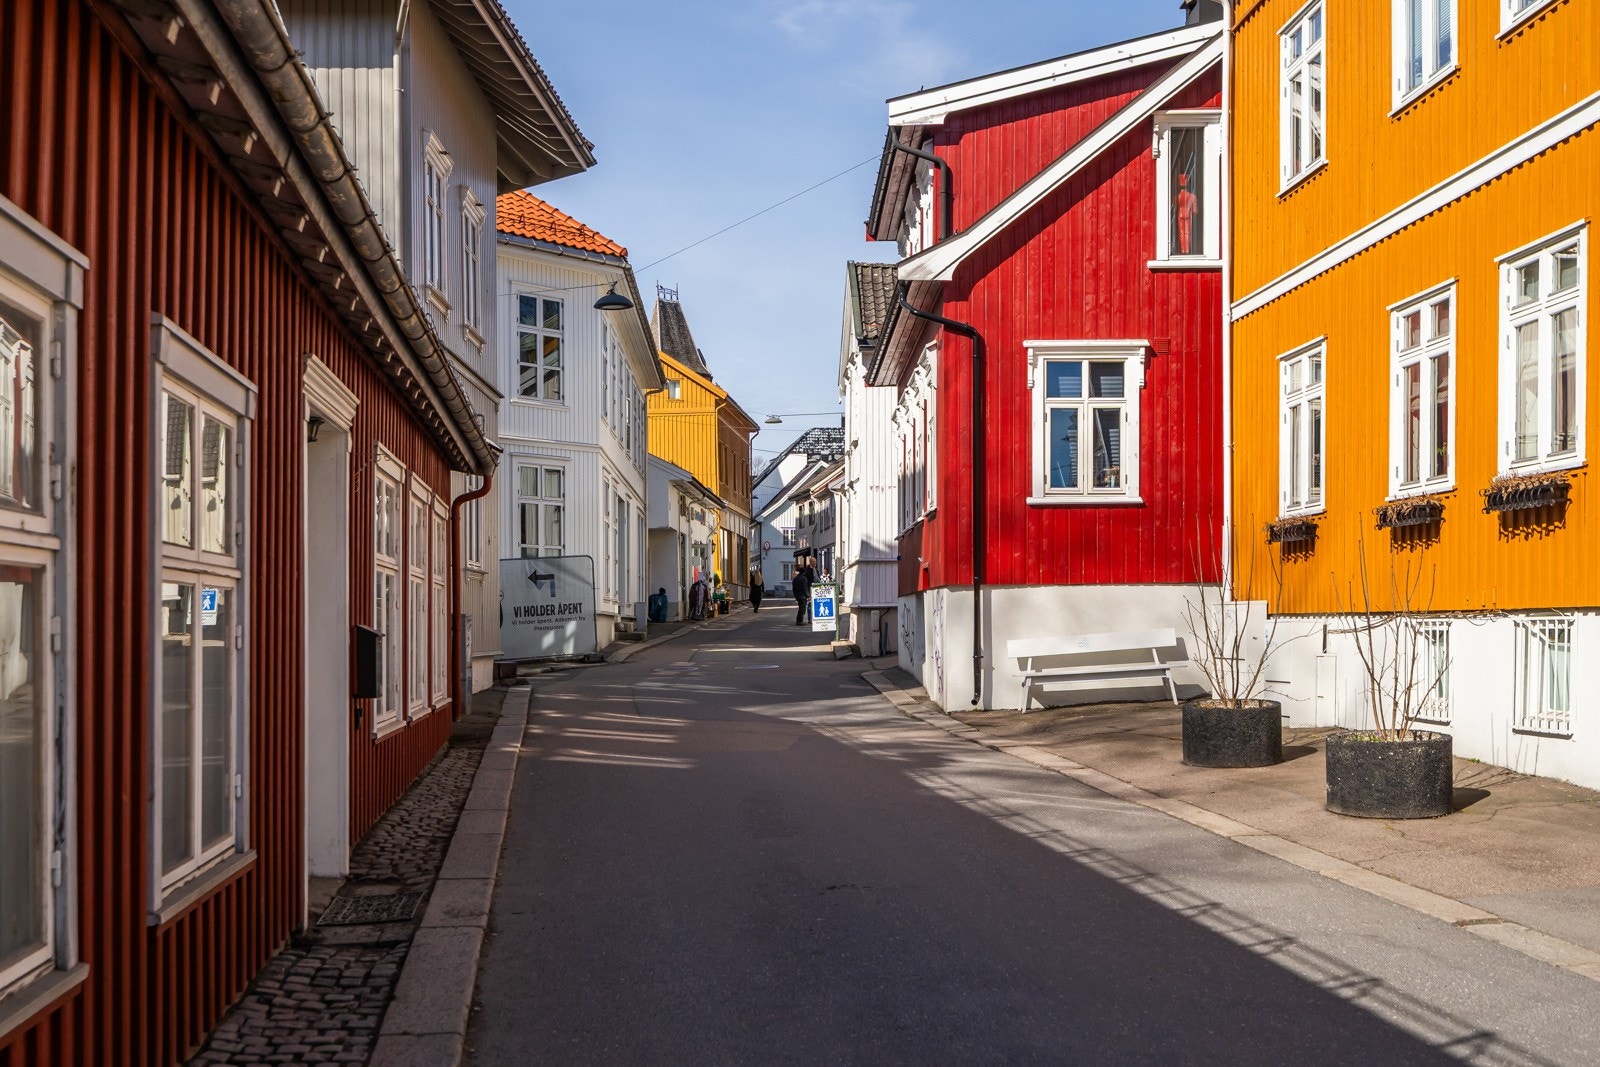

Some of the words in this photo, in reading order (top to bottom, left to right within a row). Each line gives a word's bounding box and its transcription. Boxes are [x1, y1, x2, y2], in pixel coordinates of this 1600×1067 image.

[513, 606, 522, 618] VI
[523, 604, 556, 618] HOLDER
[557, 602, 583, 615] ÅPENT
